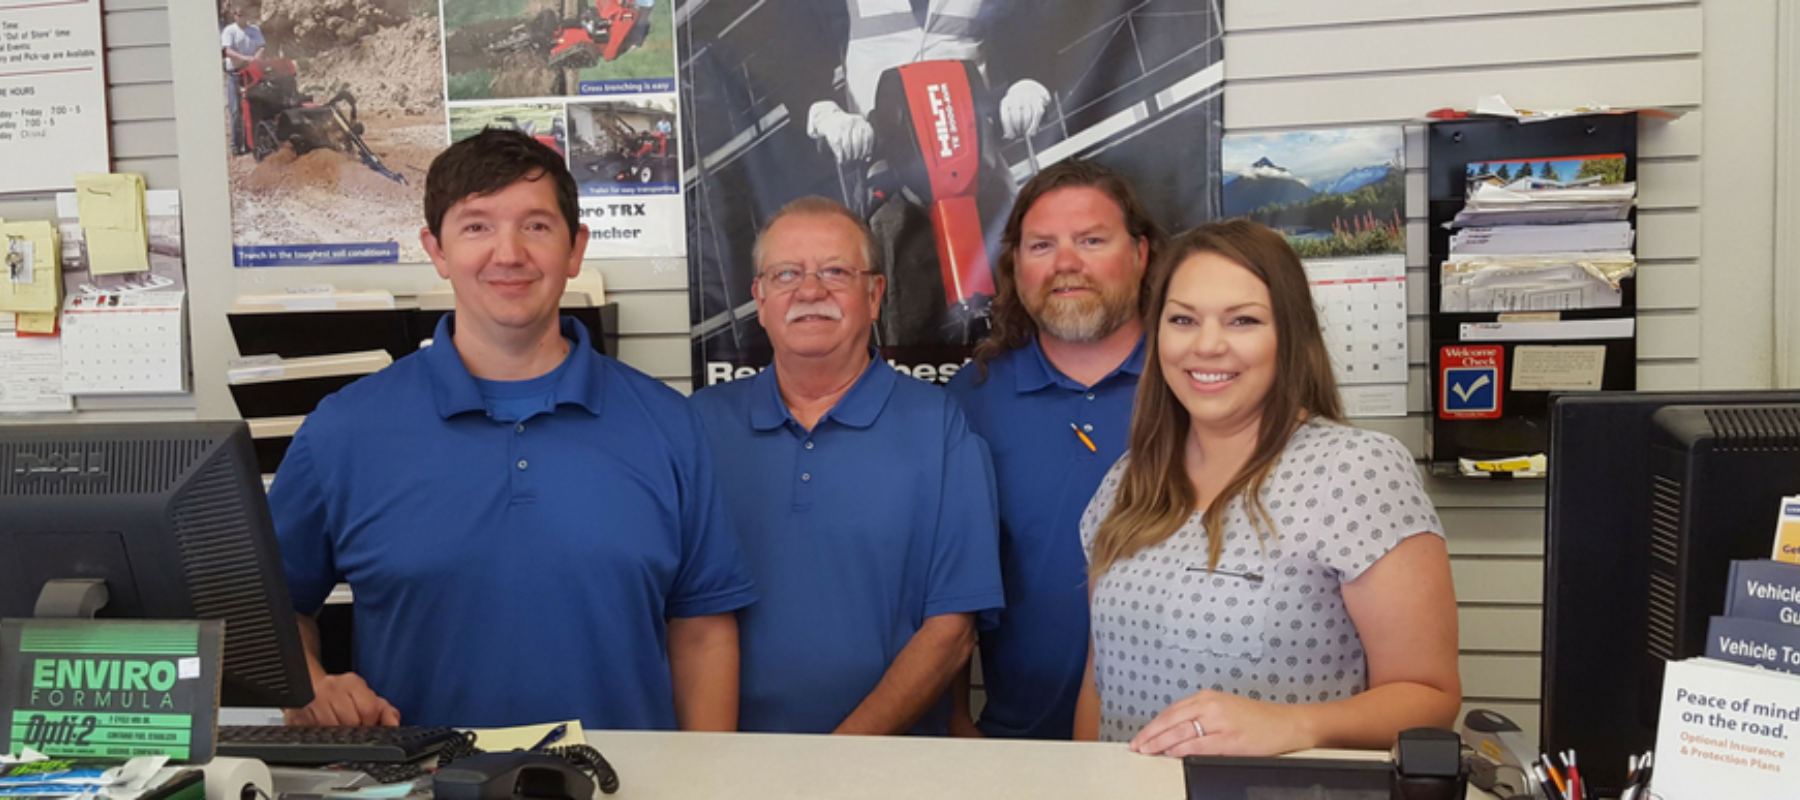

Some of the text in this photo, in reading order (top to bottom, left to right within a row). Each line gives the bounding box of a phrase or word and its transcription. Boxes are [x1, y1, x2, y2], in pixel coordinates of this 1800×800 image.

[9, 86, 35, 96] HOURS
[581, 82, 669, 93] Cross trenching is easy
[21, 107, 43, 117] Friday
[926, 84, 953, 157] HILTI
[610, 186, 620, 194] for
[608, 203, 646, 217] TRX
[239, 248, 390, 261] Trench in the toughest soil conditions
[1446, 348, 1496, 357] Welcome
[1462, 357, 1496, 366] Check
[1719, 636, 1777, 661] Vehicle
[33, 659, 177, 691] ENVIRO
[30, 690, 173, 709] FORMULA
[1677, 687, 1800, 722] Peace of mind
[1682, 711, 1788, 740] on the road.
[1680, 731, 1785, 758] Optional Insurance
[1680, 745, 1781, 773] & Protection Plans
